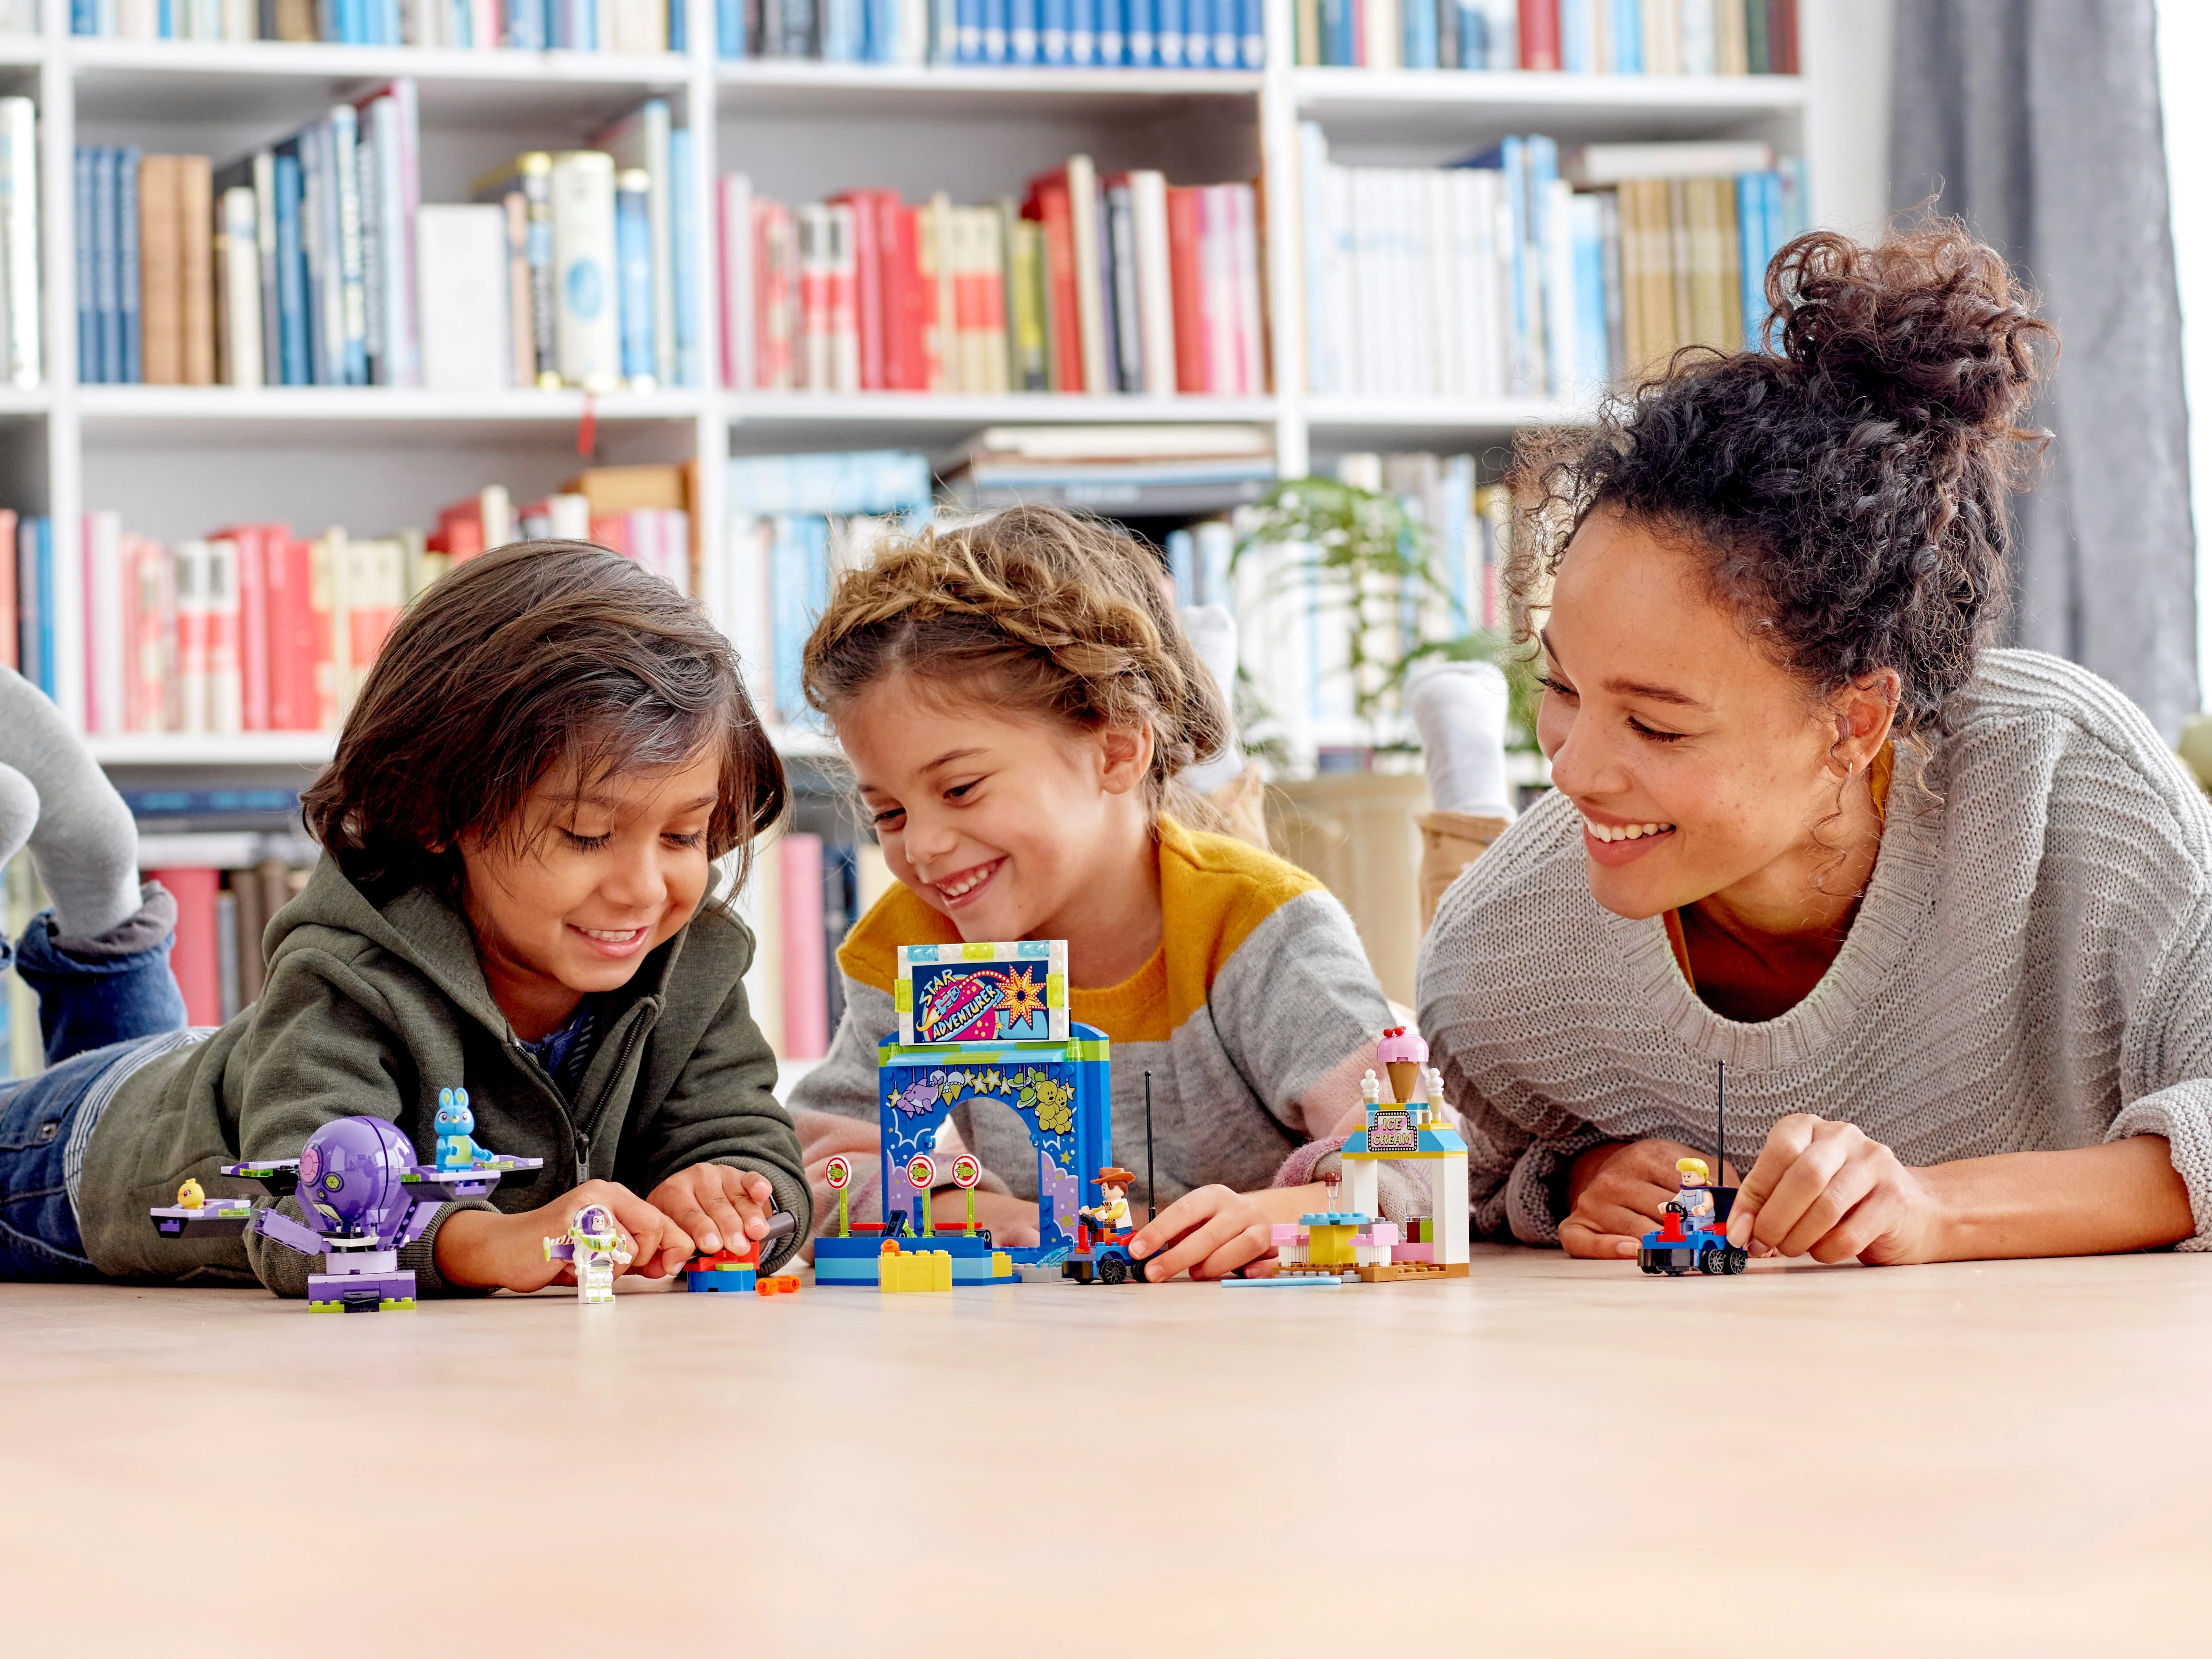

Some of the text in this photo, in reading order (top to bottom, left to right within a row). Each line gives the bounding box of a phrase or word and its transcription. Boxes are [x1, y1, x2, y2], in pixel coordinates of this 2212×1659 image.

[919, 969, 957, 1006] STAR
[933, 985, 998, 1039] ADVENTURER
[1383, 1118, 1402, 1130] ICE
[1373, 1133, 1412, 1145] CREAM
